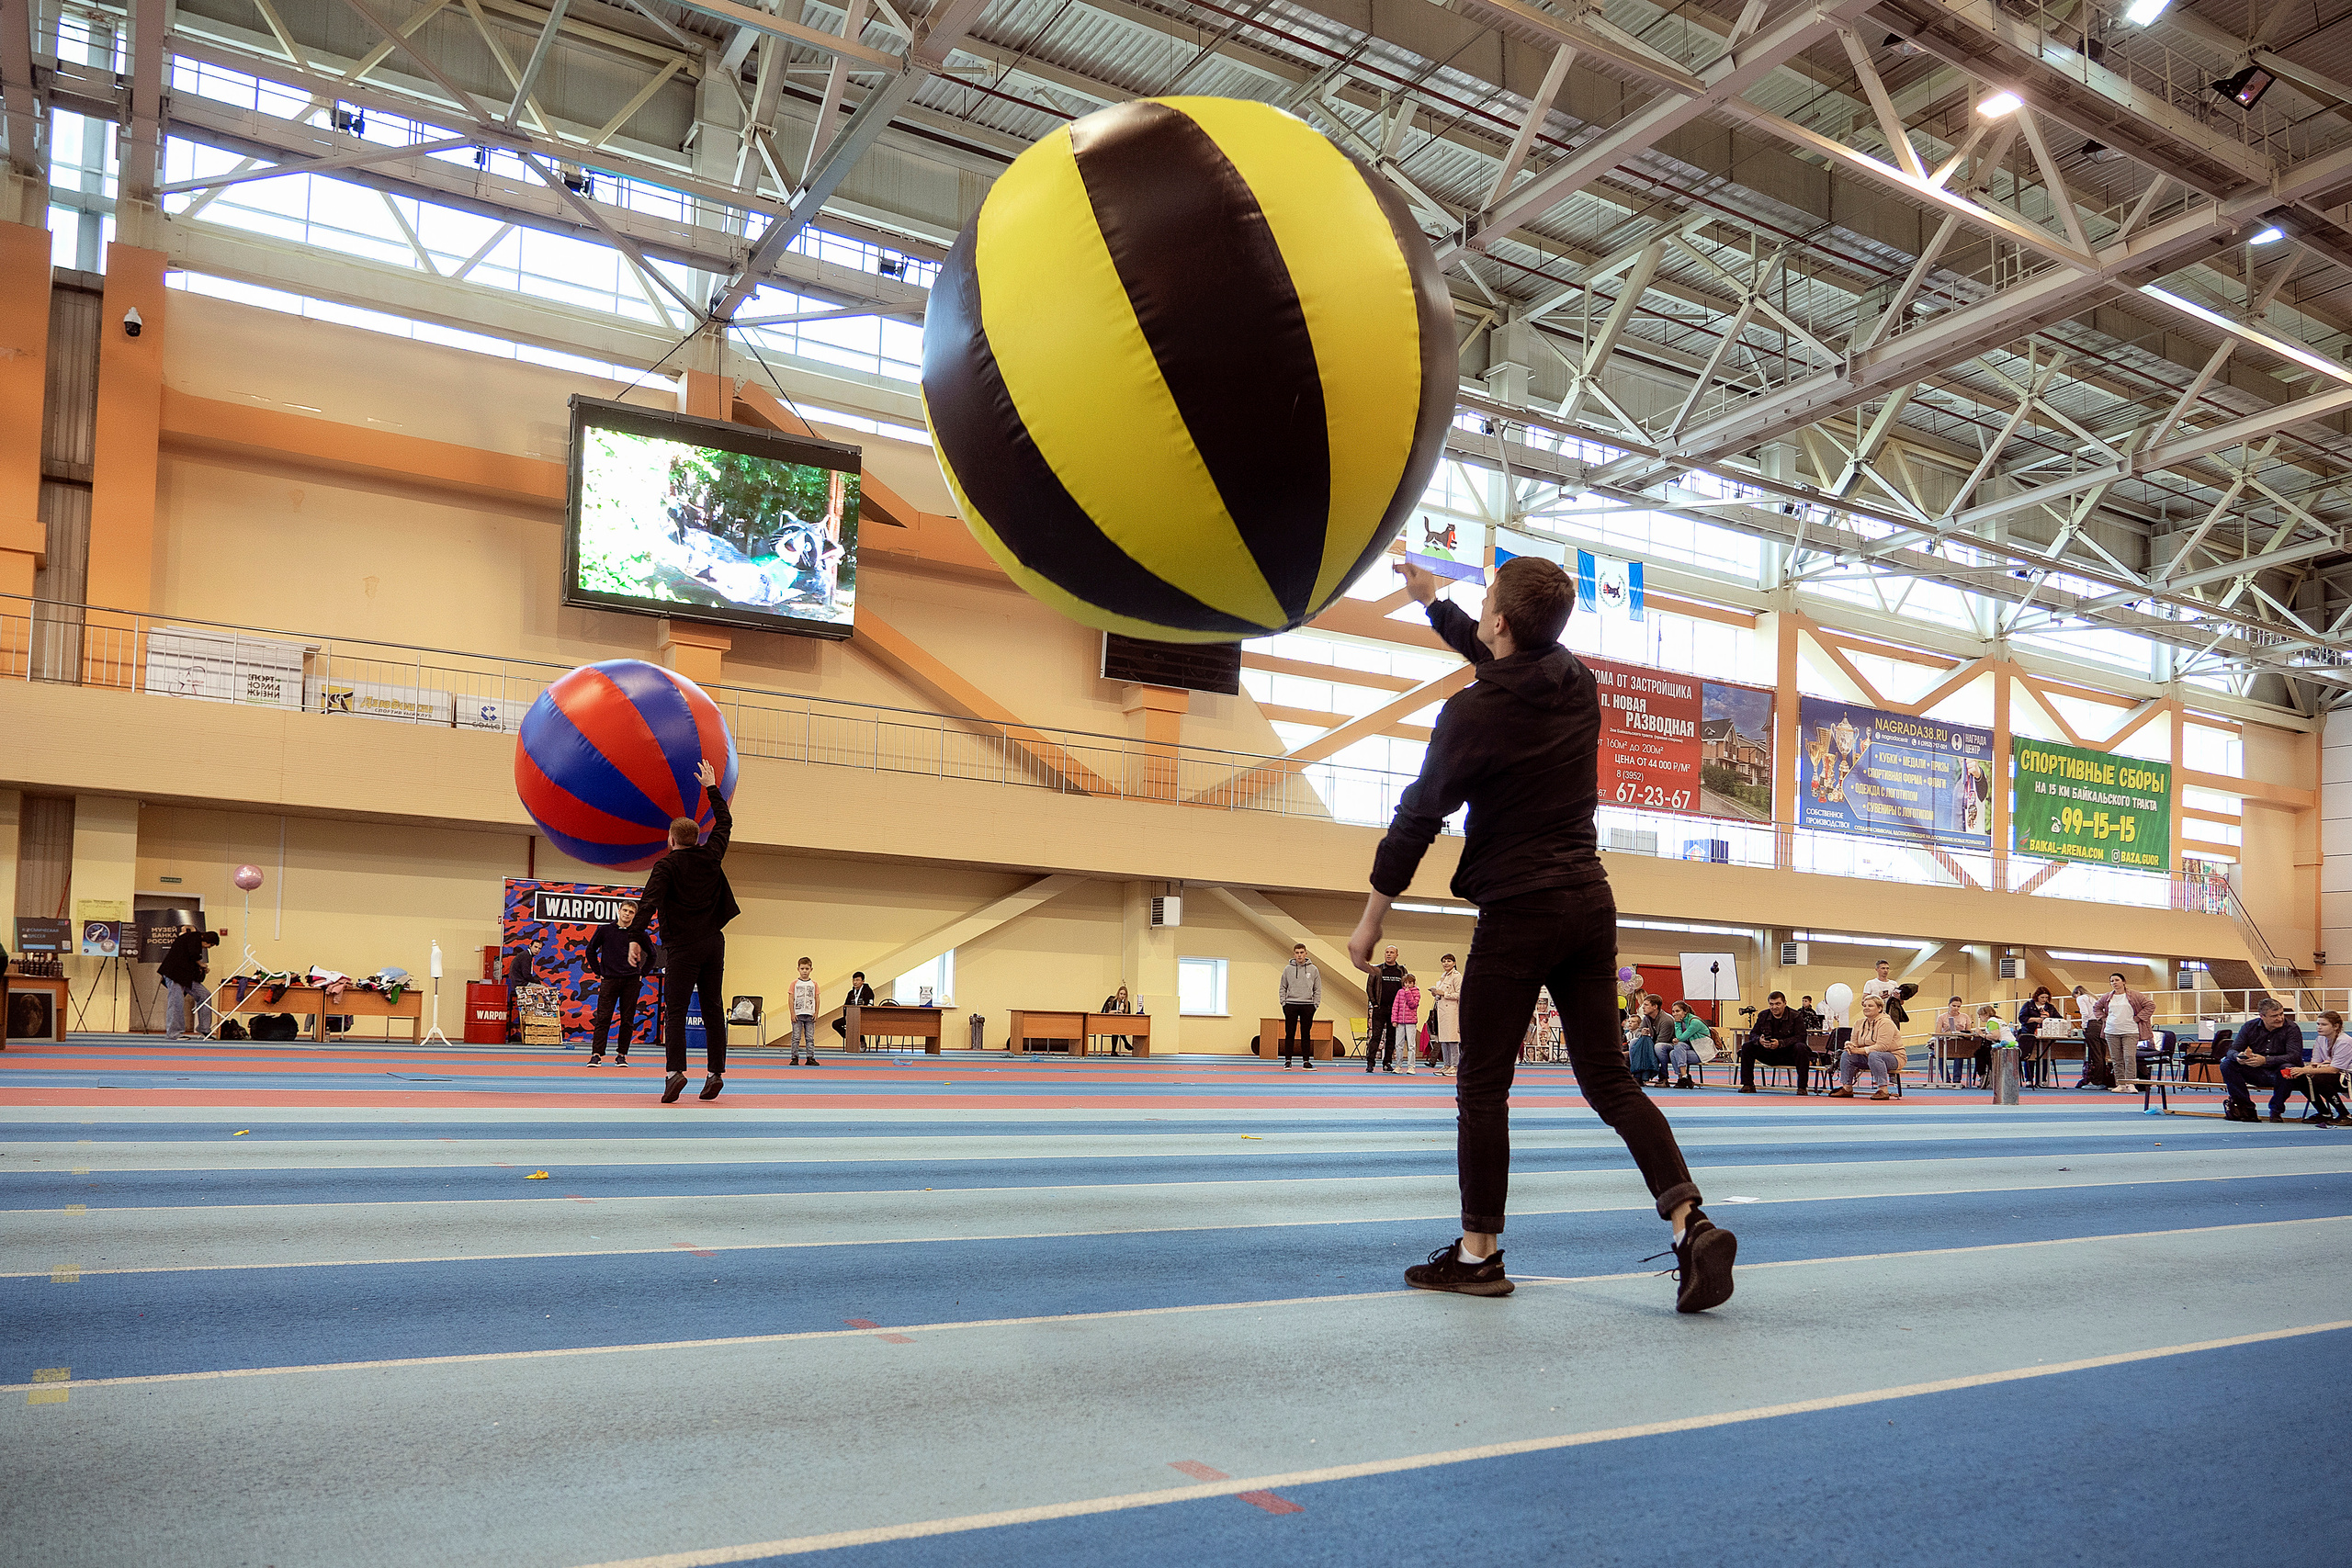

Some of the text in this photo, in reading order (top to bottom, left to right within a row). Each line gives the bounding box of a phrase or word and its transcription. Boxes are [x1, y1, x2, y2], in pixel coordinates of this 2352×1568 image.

[247, 682, 280, 691] НОРМА
[248, 673, 275, 682] СПОРТ
[1617, 673, 1628, 689] ОТ
[1630, 676, 1692, 700] ЗАСТРОЙЩИКА
[247, 689, 280, 698] ЖИЗНИ
[1613, 694, 1646, 713] НОВАЯ
[1625, 711, 1695, 738] РАЗВОДНАЯ
[1875, 717, 1948, 742] NAGRADA38.RU
[1964, 733, 1986, 746] НАГРАДА
[1964, 743, 1981, 755] ЦЕНТР
[1614, 754, 1635, 765] ЦЕНА
[1636, 757, 1647, 767] ОТ
[1648, 759, 1657, 768] 44
[1658, 761, 1672, 770] 000
[1879, 752, 1950, 773] КУБКИ МЕДАЛИ ПРИЗЫ
[2020, 749, 2165, 794] СПОРТИВНЫЕ СБОРЫ
[1616, 770, 1645, 783] 8 (3952)
[1867, 768, 1947, 789] СПОРТИВНАЯ ФОРМА ФЛАГИ
[1616, 782, 1691, 809] 67-23-67
[1855, 784, 1918, 802] ОДЕЖДА С ЛОГОТИПОМ
[2035, 782, 2157, 812] НА 15 КМ БАЙКАЛЬСКОГО ТРАКТА
[1805, 807, 1844, 819] СОБСТВЕННОЕ
[1866, 803, 1934, 821] СУВЕНИРЫ С ЛОГОТИПОМ
[2061, 807, 2136, 842] 99-15-15
[2030, 840, 2159, 866] BAIKAL-ARENA.COM BAZA.GUOR
[545, 897, 622, 920] WARPOIN
[685, 1016, 705, 1026] ARP
